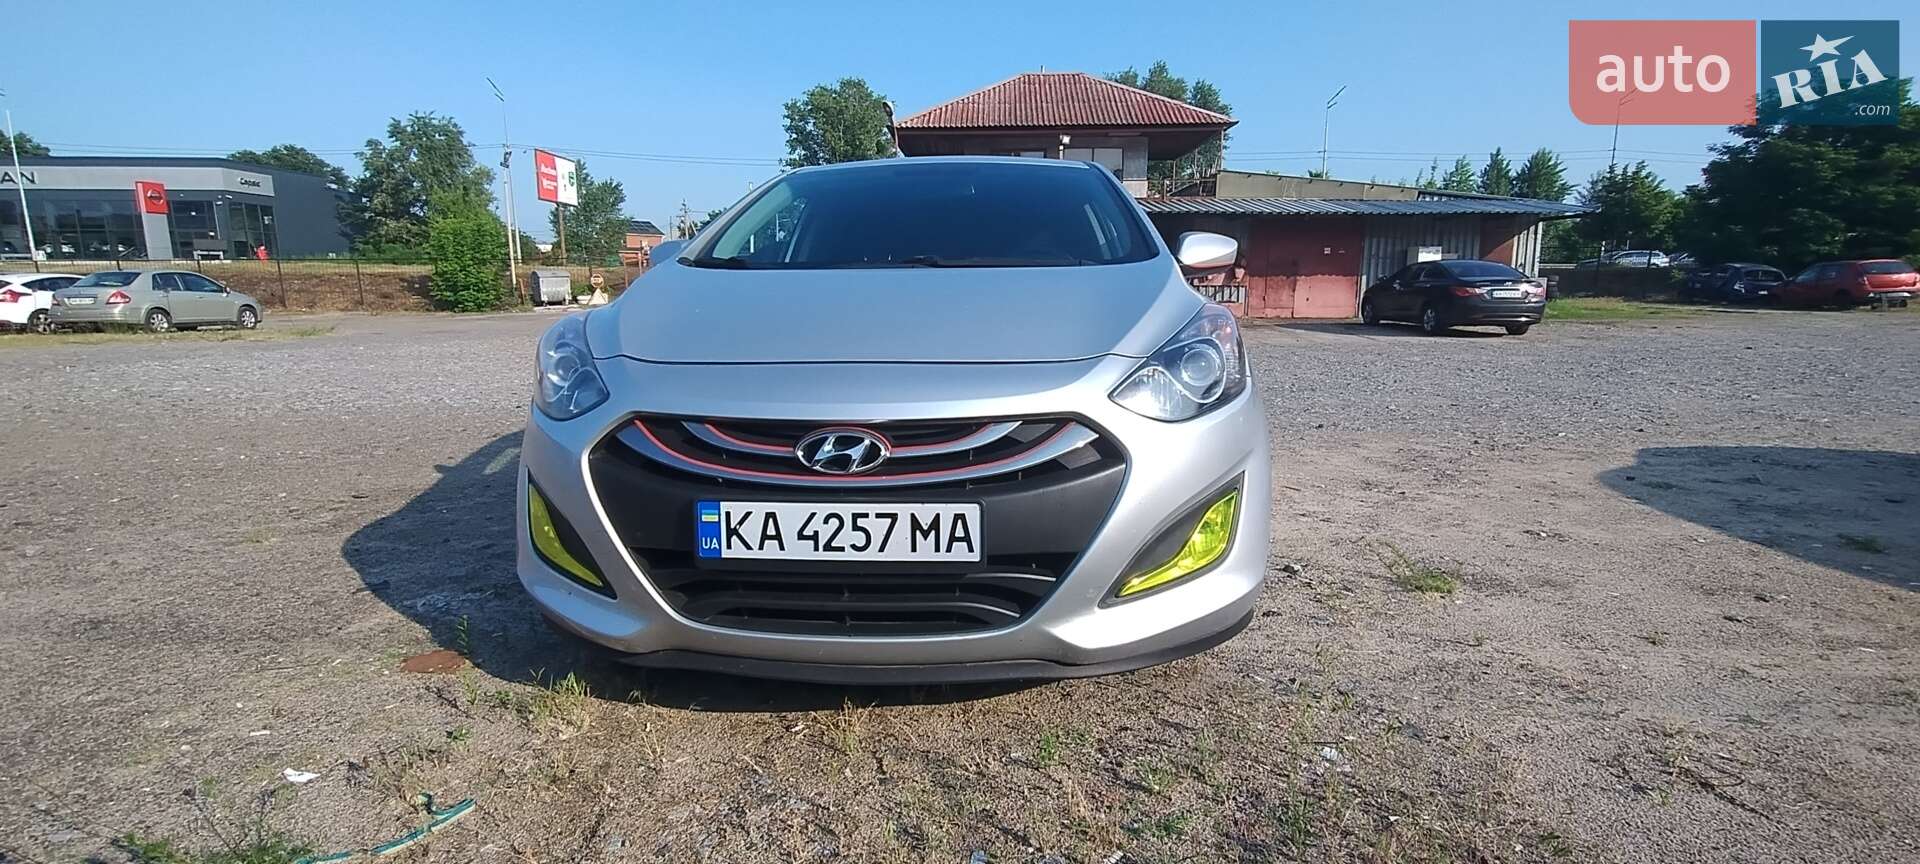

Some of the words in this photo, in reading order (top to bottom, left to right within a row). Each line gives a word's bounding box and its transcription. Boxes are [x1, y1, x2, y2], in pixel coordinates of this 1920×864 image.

[702, 537, 720, 551] UA
[724, 510, 785, 552] KA
[797, 511, 898, 553] 4257
[910, 512, 975, 553] MA
